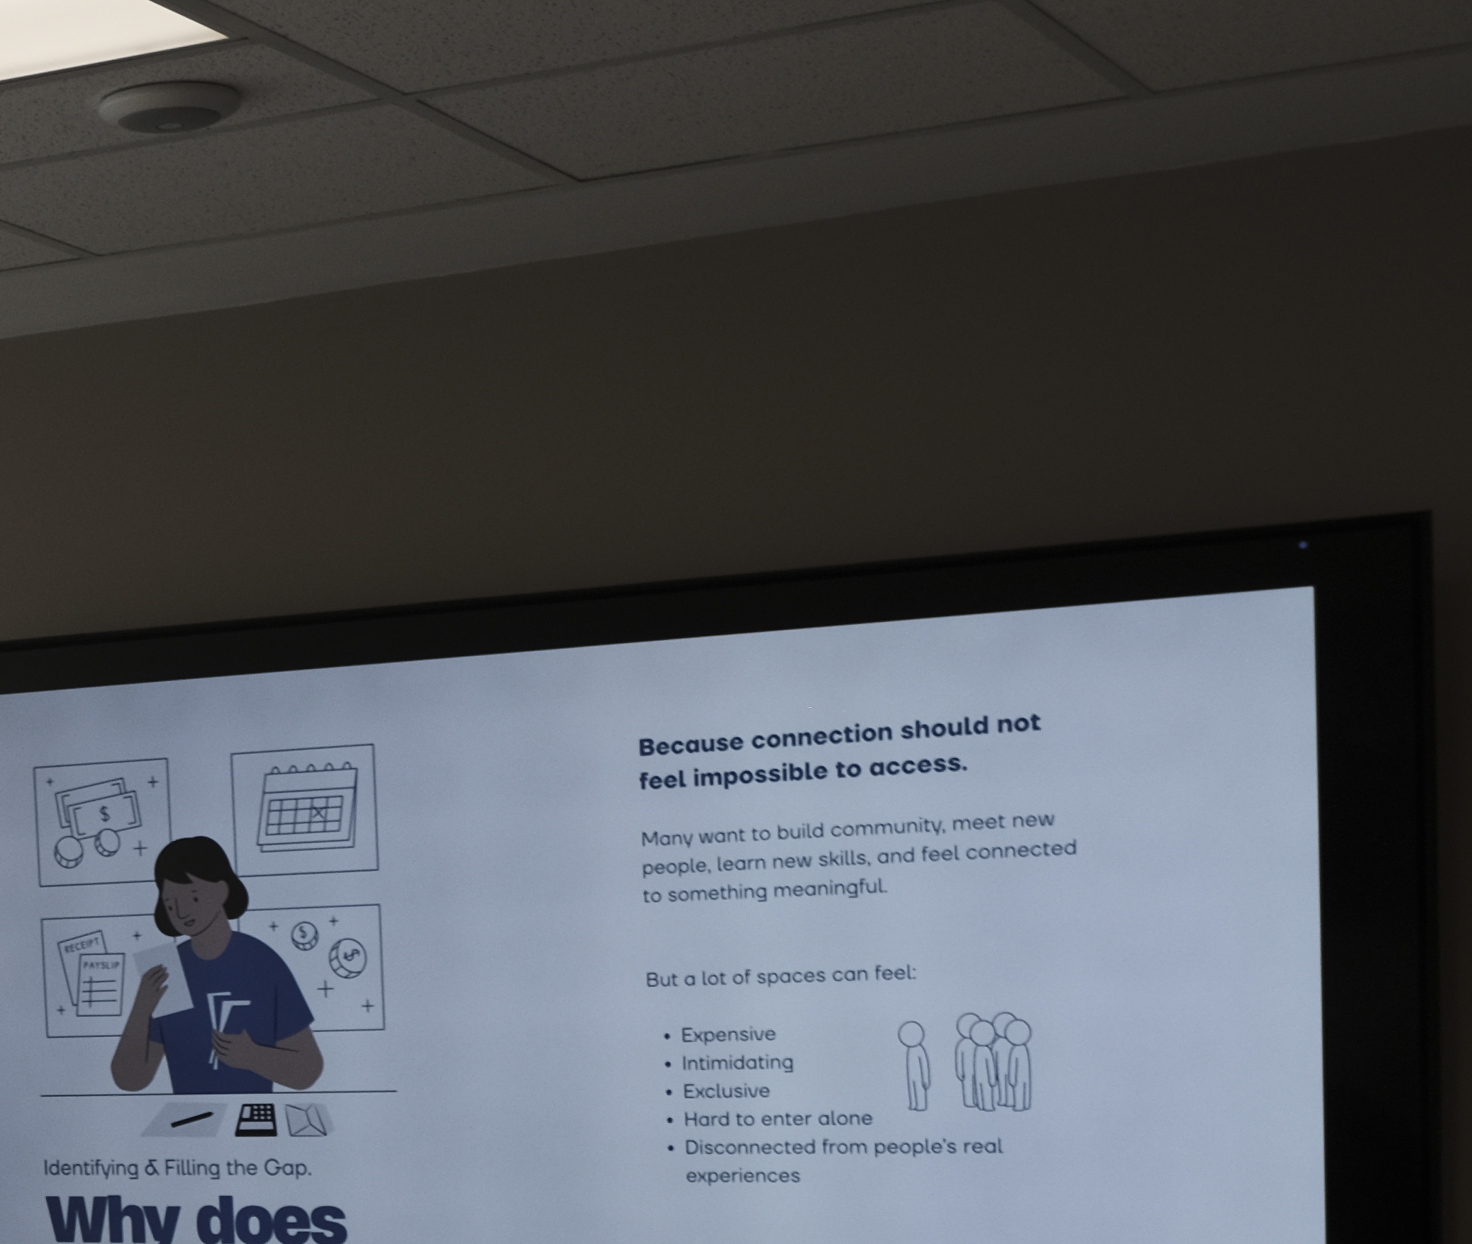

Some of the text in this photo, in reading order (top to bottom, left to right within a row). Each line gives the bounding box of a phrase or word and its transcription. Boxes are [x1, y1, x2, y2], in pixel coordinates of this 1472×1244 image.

[639, 713, 1042, 757] Because connection should not
[639, 756, 968, 791] feel impossible to access.
[641, 813, 1056, 848] Many want to build community, meet new
[642, 839, 1078, 879] people, learn new skills, and feel connected
[642, 877, 888, 904] to something meaningful.
[63, 936, 100, 954] RECEIPT
[82, 960, 121, 970] PAYSLIP
[646, 964, 916, 988] But a lot of spaces can feel:
[681, 1026, 777, 1046] Expensive
[682, 1054, 794, 1074] Intimidating
[683, 1082, 771, 1100] Exclusive
[684, 1110, 873, 1127] Hard to enter alone
[684, 1137, 1004, 1158] Disconnected from people's real
[43, 1157, 312, 1180] Identifying & Filling the Gap.
[685, 1168, 801, 1187] experiences
